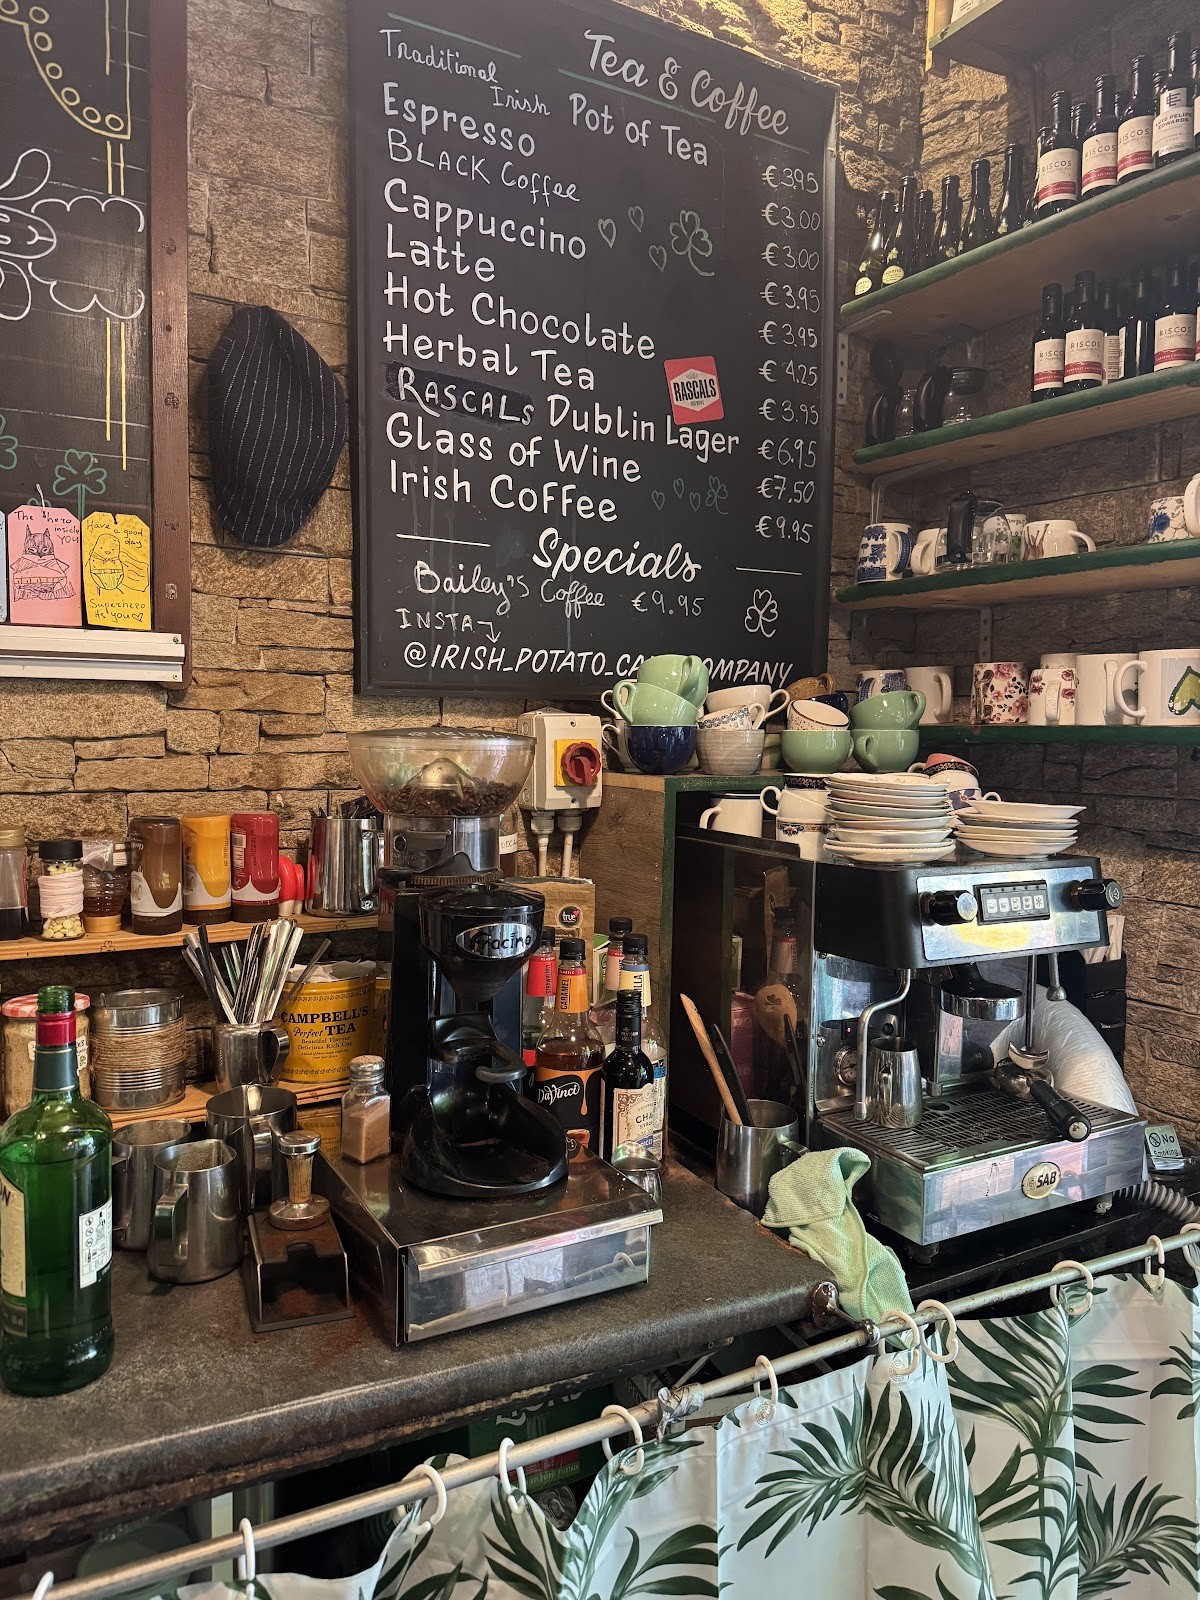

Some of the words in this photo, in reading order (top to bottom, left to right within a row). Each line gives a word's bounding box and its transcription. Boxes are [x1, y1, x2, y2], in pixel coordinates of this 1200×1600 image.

[379, 29, 499, 84] Traditional
[583, 29, 649, 88] Tea
[658, 56, 682, 100] &
[690, 68, 789, 136] Coffee
[489, 85, 551, 116] Irish
[383, 81, 536, 158] Espresso
[568, 92, 615, 135] Pot
[625, 119, 651, 147] of
[660, 124, 708, 167] Tea
[1084, 144, 1116, 159] RISCOS
[387, 128, 491, 185] BLACK
[500, 161, 580, 208] Coffee
[1041, 160, 1072, 174] RISCOS
[383, 178, 586, 260] Cappuccino
[760, 202, 821, 231] €3.00
[386, 222, 496, 283] Latte
[760, 242, 820, 271] €3.00
[759, 281, 820, 314] €3.95
[383, 271, 455, 317] Hot
[471, 292, 656, 360] Chocolate
[757, 320, 818, 349] €3.95
[1159, 326, 1192, 337] RISCOS
[382, 320, 519, 377] Herbal
[530, 349, 596, 391] Tea
[1039, 350, 1063, 359] RISCO
[673, 378, 717, 402] RASCALS
[398, 366, 536, 427] RASCALS
[546, 394, 656, 443] Dublin
[666, 414, 740, 464] Lager
[758, 397, 819, 426] €3.95
[385, 411, 494, 461] Glass
[508, 435, 543, 468] of
[553, 438, 642, 483] Wine
[757, 437, 818, 470] €6.95
[389, 458, 471, 503] Irish
[489, 473, 619, 523] Coffee
[13, 510, 35, 522] The
[46, 511, 72, 524] hero
[53, 524, 80, 535] inside
[86, 519, 111, 531] Have
[755, 515, 814, 544] €9.95
[123, 527, 143, 539] good
[124, 539, 143, 549] day
[531, 526, 702, 584] Specials
[413, 560, 531, 617] Bailey's
[540, 577, 606, 619] Coffee
[631, 589, 705, 617] €9.95
[89, 598, 146, 615] Superhero
[394, 607, 475, 633] INSTA
[562, 911, 576, 921] true
[560, 979, 570, 1010] CARAMEL
[280, 1005, 368, 1024] CAMPBELL'S
[293, 1027, 323, 1039] Perfect
[325, 1022, 357, 1036] TEA
[538, 1081, 581, 1106] DaVinci
[1160, 1133, 1176, 1145] No
[1036, 1171, 1057, 1189] SAB
